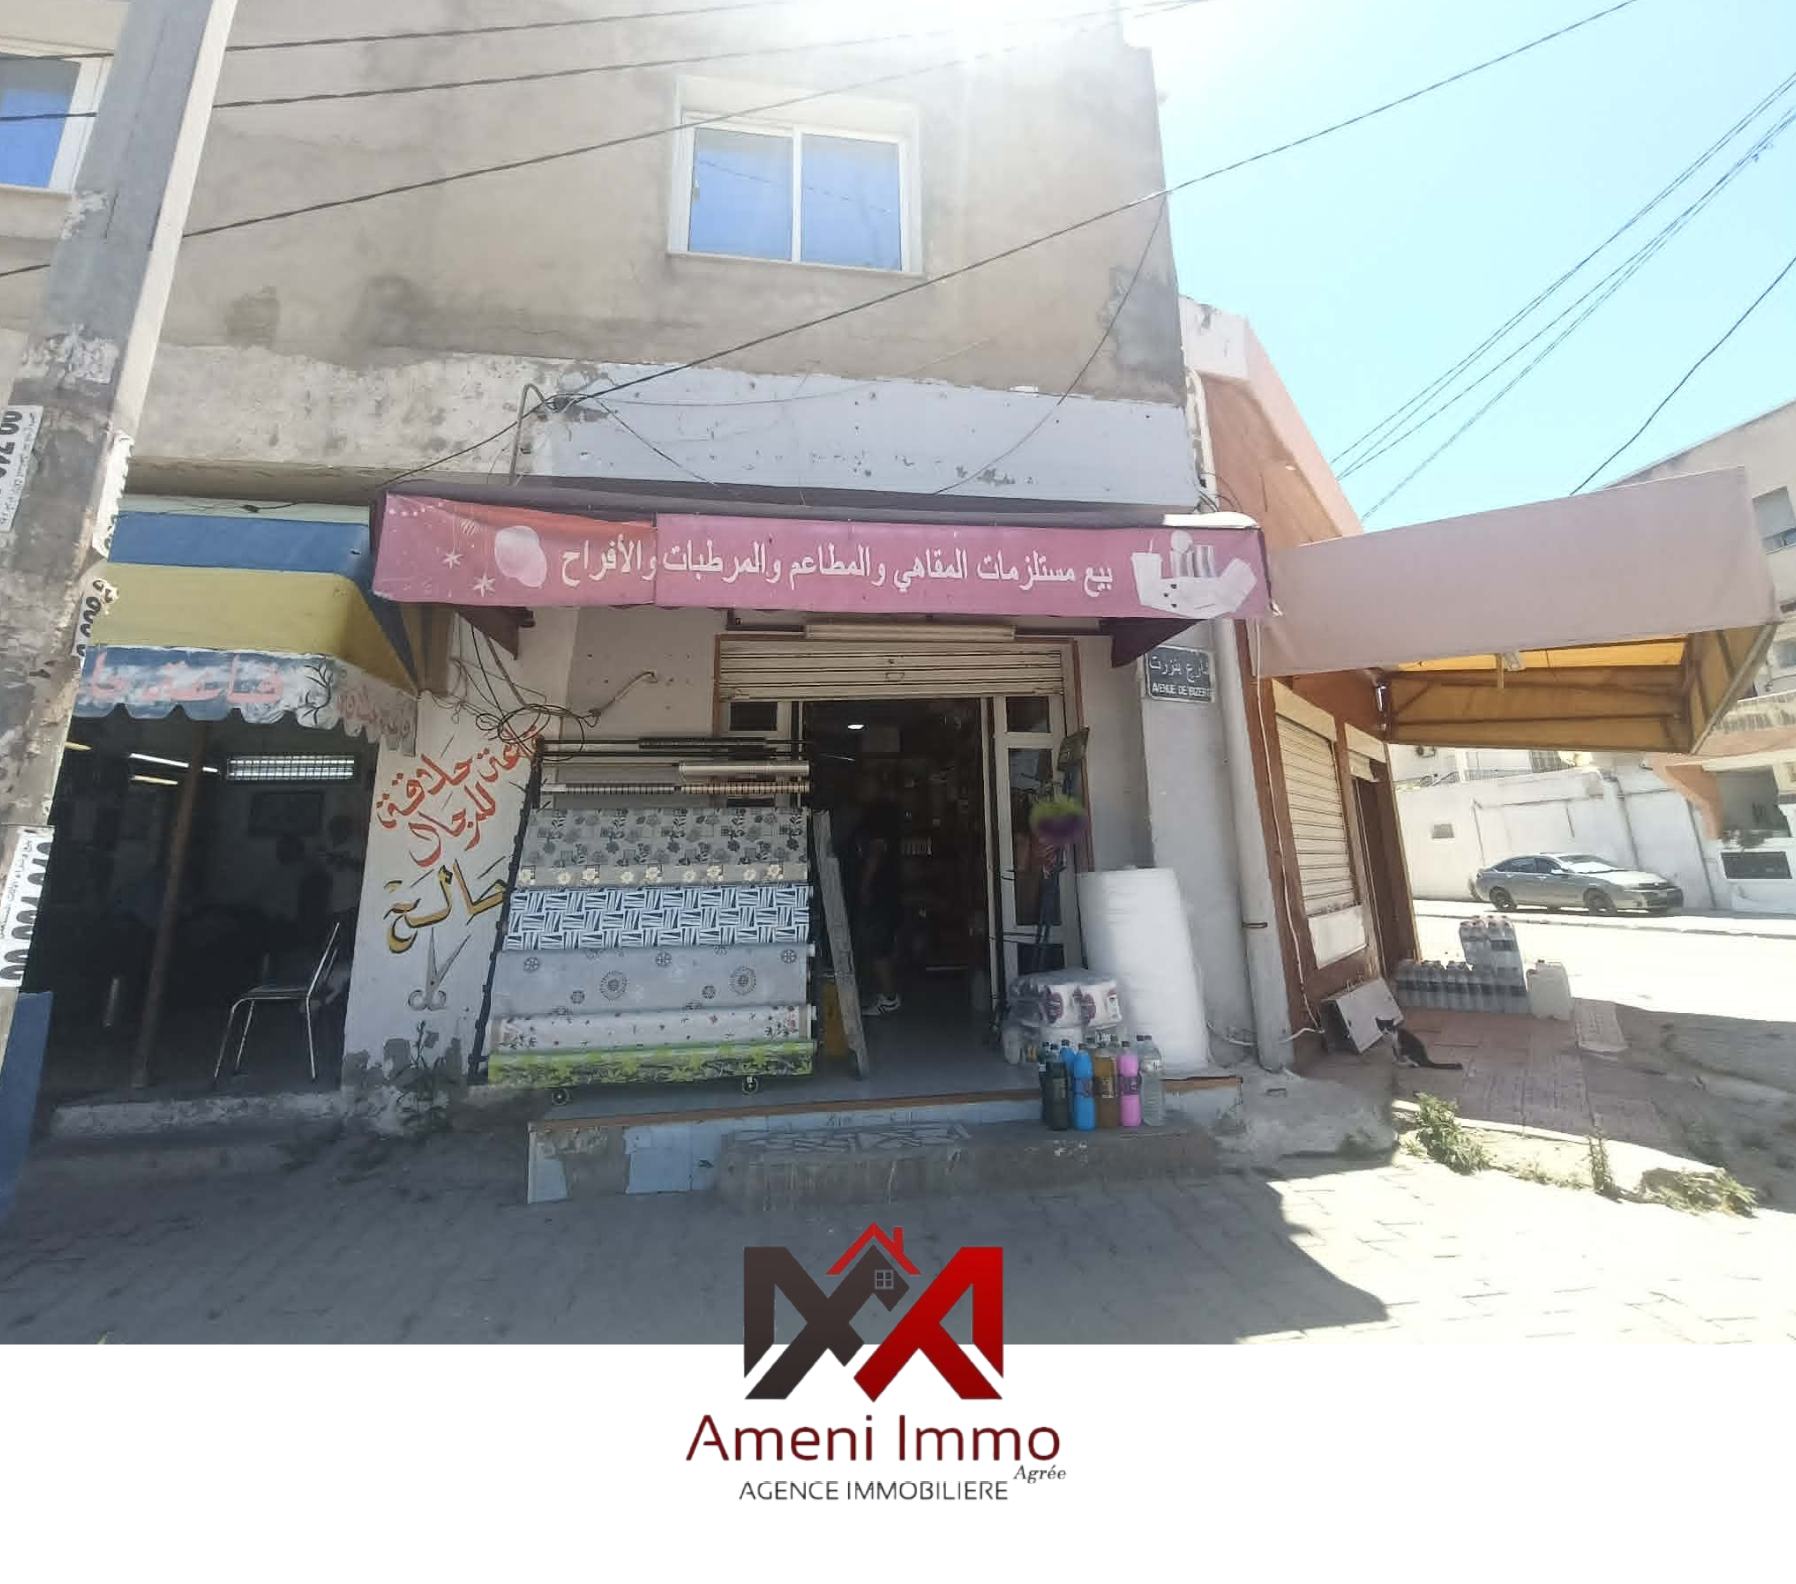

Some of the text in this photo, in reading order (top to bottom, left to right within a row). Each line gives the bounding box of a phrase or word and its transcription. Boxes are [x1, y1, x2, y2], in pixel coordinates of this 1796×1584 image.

[662, 539, 781, 583] والمرطبات
[789, 542, 886, 590] والمطاعم
[893, 548, 968, 592] المقاهي
[977, 549, 1075, 590] مستلزمات
[1083, 565, 1113, 597] بيع
[1151, 683, 1177, 694] AVENUE
[1178, 685, 1188, 695] DE
